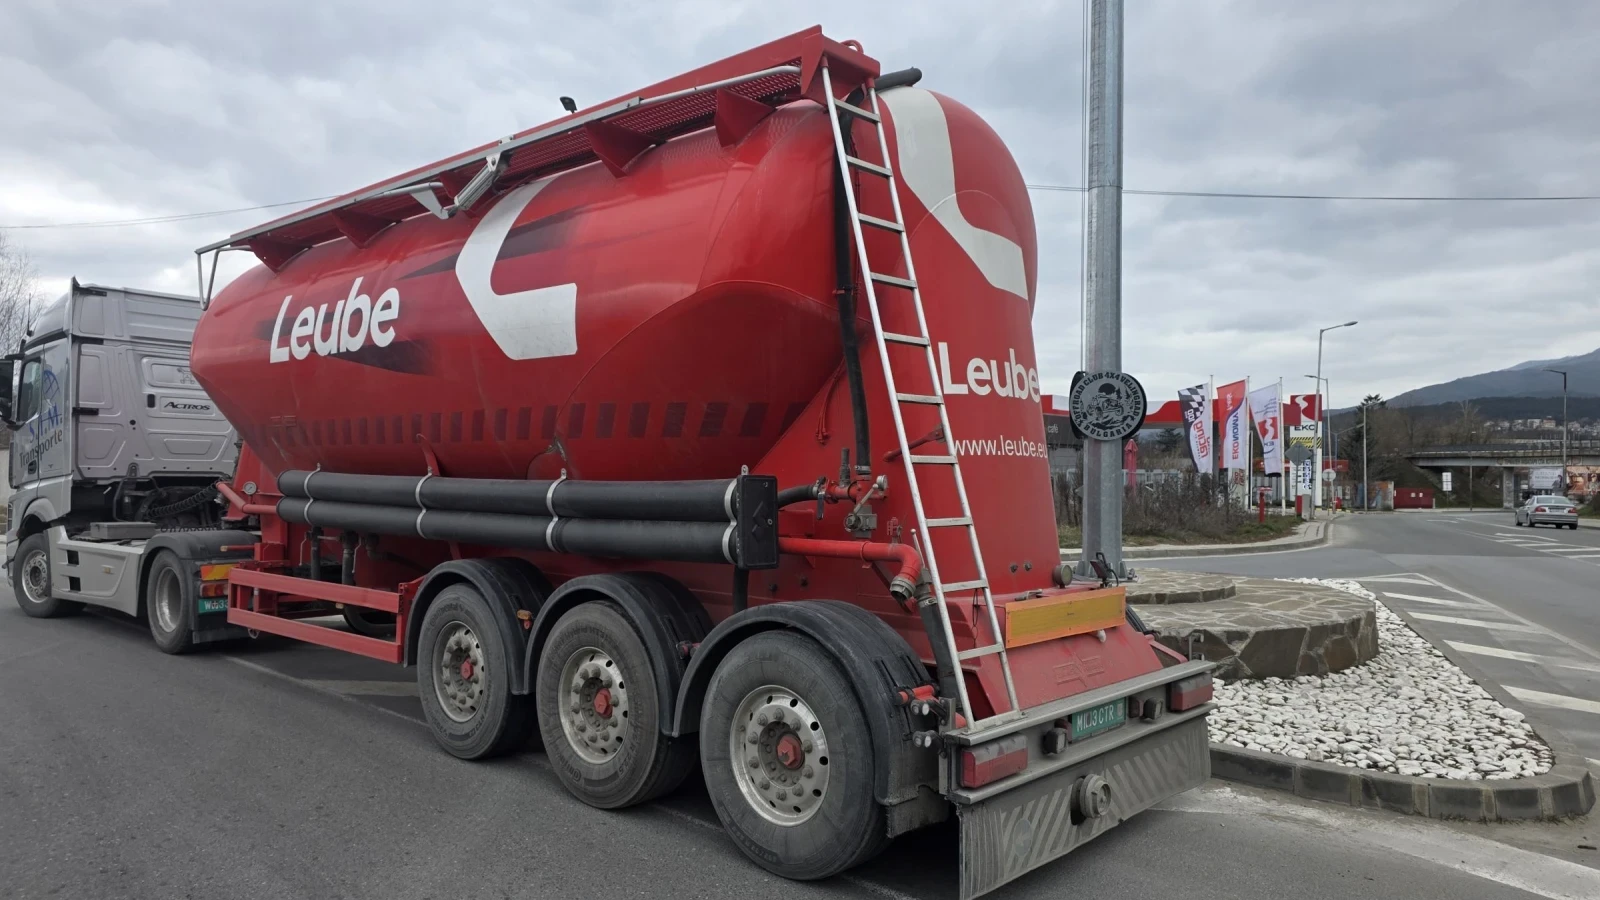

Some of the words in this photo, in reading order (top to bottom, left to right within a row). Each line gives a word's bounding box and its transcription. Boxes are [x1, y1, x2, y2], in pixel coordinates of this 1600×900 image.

[269, 276, 400, 364] Leube
[938, 341, 1041, 403] Leube
[1072, 385, 1085, 420] OFFROAD
[1083, 372, 1104, 387] CLUB
[1120, 375, 1141, 418] VELINGRAD
[19, 429, 63, 468] Transporte
[953, 434, 1048, 459] www.leube.eu
[1083, 422, 1133, 438] BULGARIA
